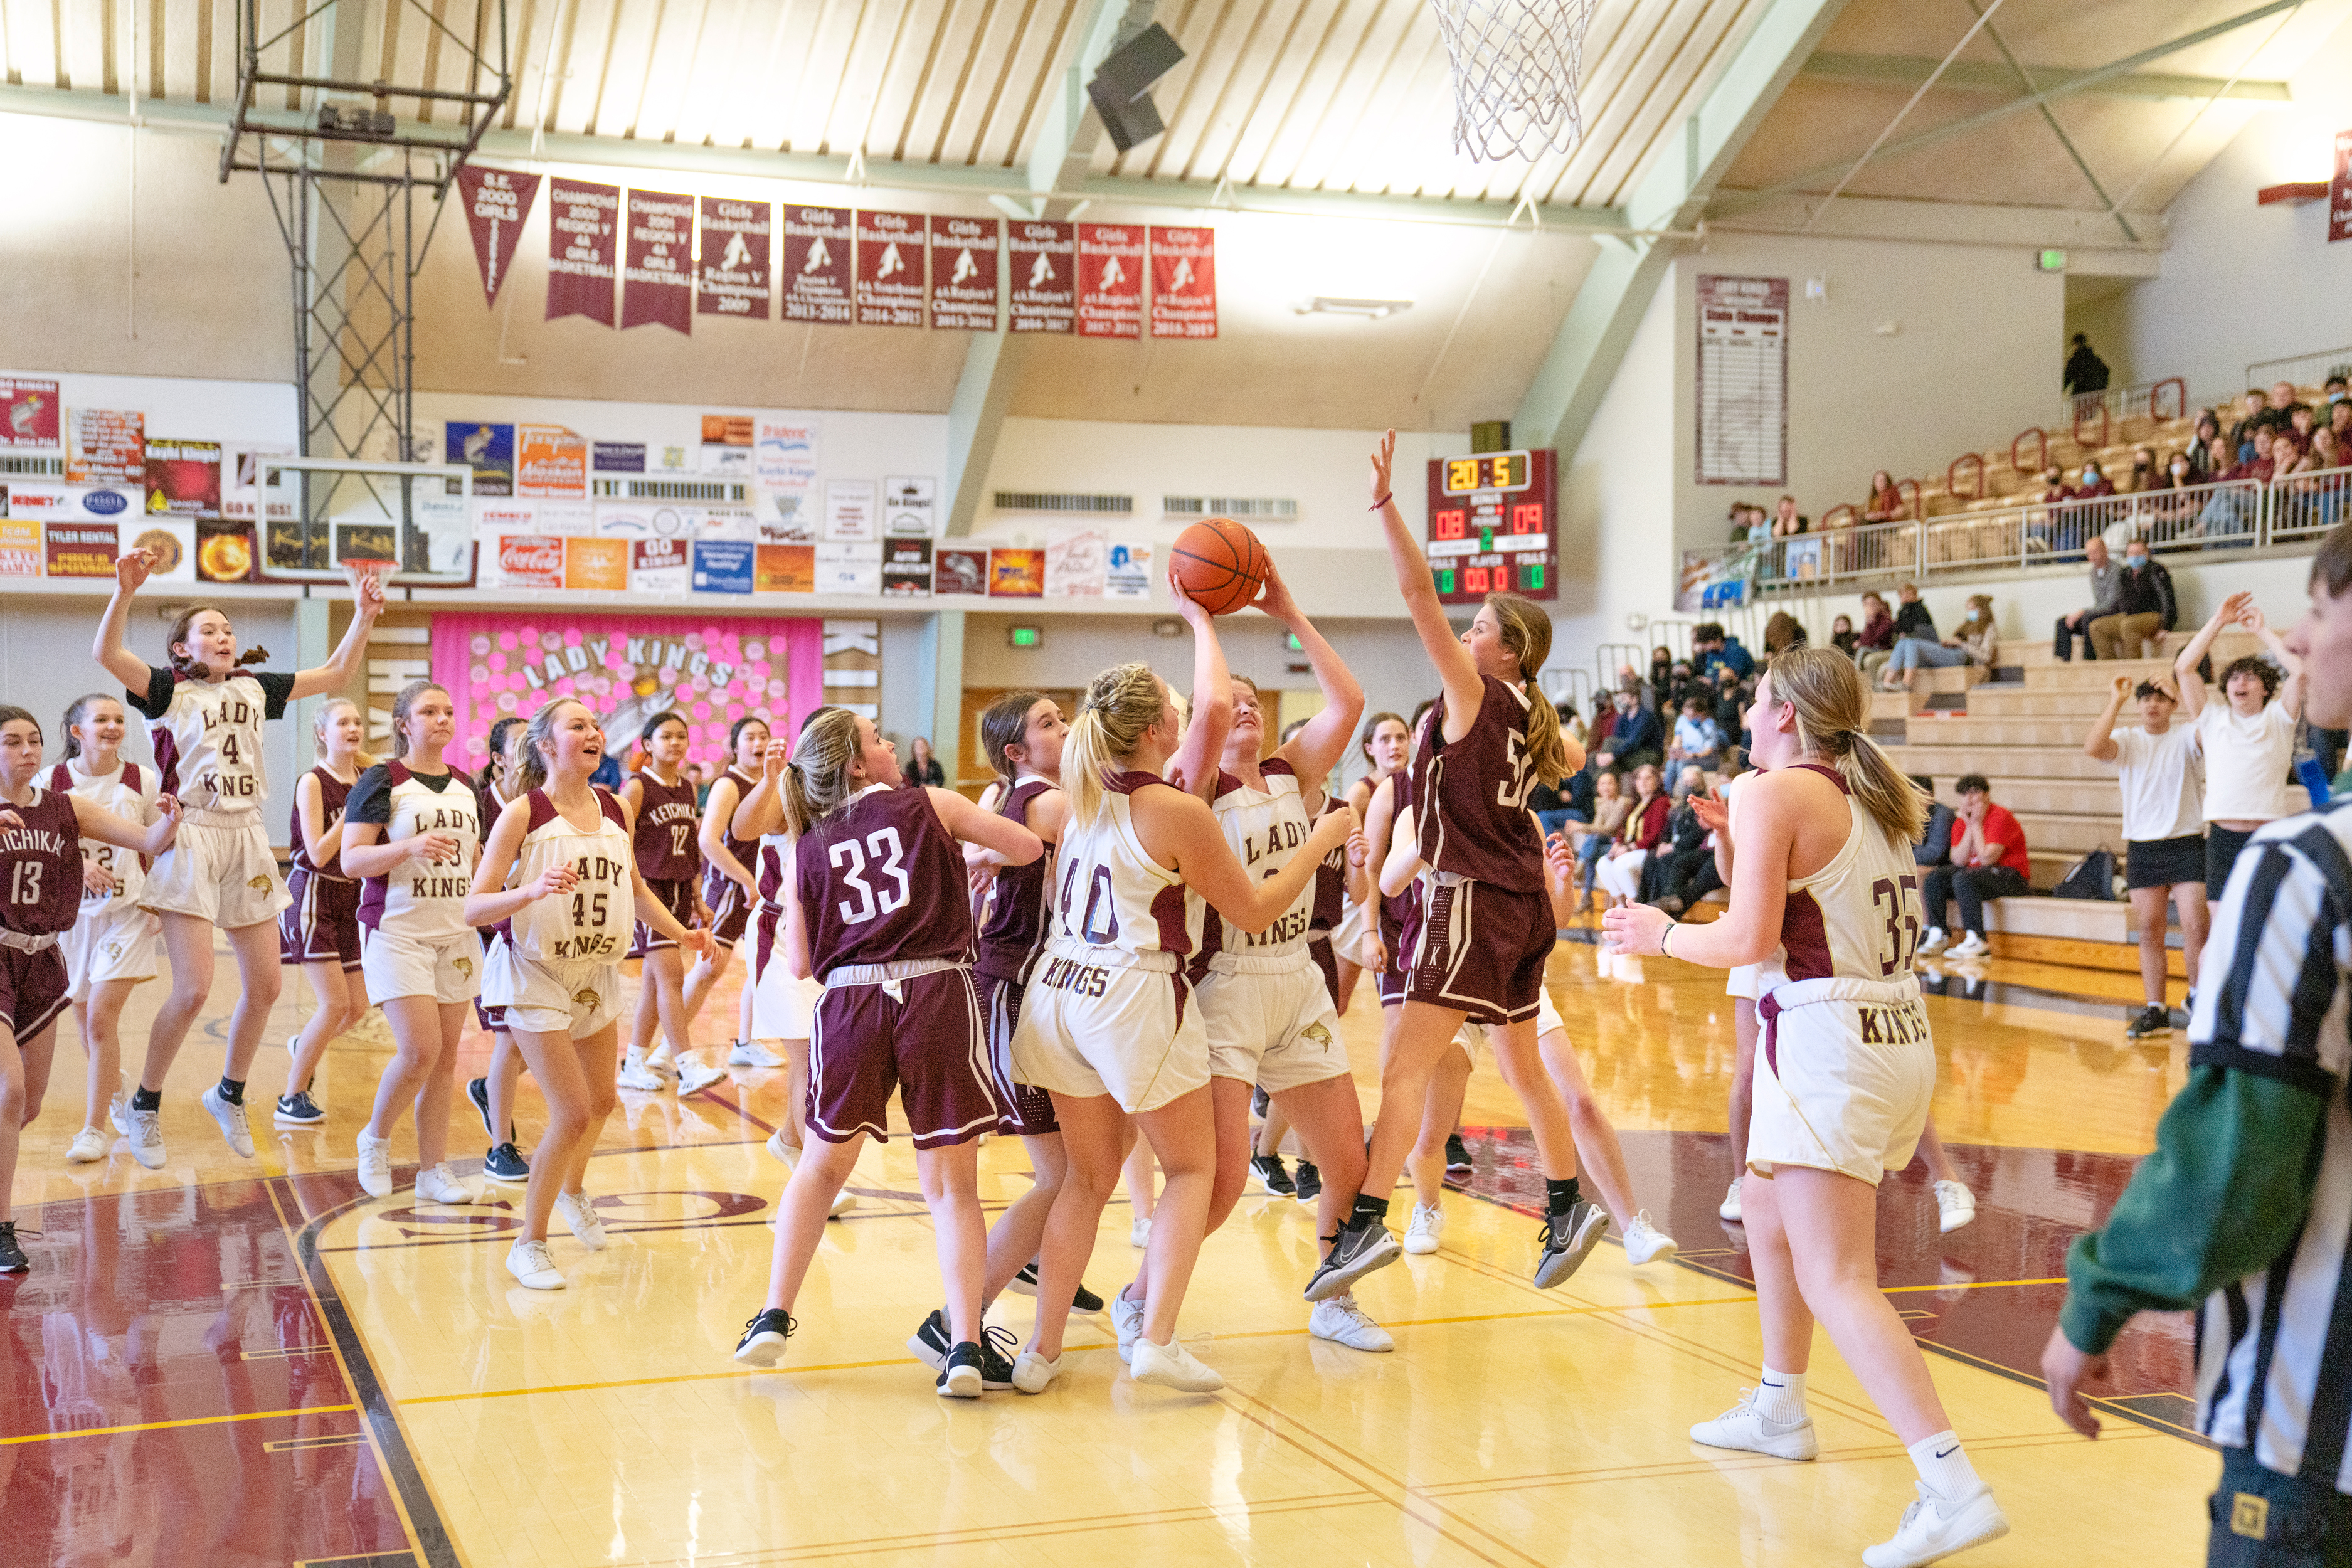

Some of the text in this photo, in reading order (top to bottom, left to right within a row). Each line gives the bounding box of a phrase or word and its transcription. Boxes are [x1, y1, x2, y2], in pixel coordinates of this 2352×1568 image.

[477, 188, 517, 205] 2000
[553, 189, 617, 209] CHAMPIONS
[475, 203, 519, 221] GIRLS
[630, 198, 692, 219] CHAMPIONS
[718, 202, 753, 219] Girls
[801, 208, 835, 225] Girls
[556, 217, 599, 235] REGION
[701, 215, 769, 235] Basketball
[785, 220, 851, 240] Basketball
[874, 214, 908, 230] Girls
[948, 220, 981, 236] Girls
[633, 226, 675, 244] REGION
[858, 226, 924, 245] Basketball
[1025, 224, 1057, 239] Girls
[1096, 228, 1128, 243] Girls
[1167, 230, 1198, 244] Girls
[932, 233, 997, 250] Basketball
[1010, 237, 1074, 253] Basketball
[1081, 240, 1143, 257] Basketball
[1153, 242, 1213, 257] Basketball
[566, 246, 599, 262] GIRLS
[643, 255, 676, 271] GIRLS
[549, 258, 615, 278] BASKETBALL
[625, 267, 690, 287] BASKETBALL
[705, 267, 750, 285] Region
[699, 280, 769, 299] Champions
[857, 293, 924, 309] Champions
[932, 299, 997, 315] Champions
[1010, 303, 1074, 319] Champions
[1153, 306, 1215, 322] Champions
[1436, 510, 1465, 540] 08
[1513, 504, 1543, 535] 09
[48, 531, 117, 544] TYLER RENTAL
[1480, 526, 1493, 551] 2
[1515, 552, 1547, 564] FOULS
[522, 638, 734, 689] LADY KINGS
[202, 701, 260, 731] LADY
[222, 734, 239, 765] 4
[414, 808, 477, 835] LADY
[1245, 822, 1306, 866] LADY
[572, 857, 623, 887] ADY
[829, 827, 911, 925] 33
[11, 861, 43, 904] 13
[572, 893, 607, 926] 45
[1060, 857, 1120, 945] 40
[1872, 874, 1919, 977] 35
[1429, 946, 1441, 967] K
[1042, 956, 1110, 998] KINGS
